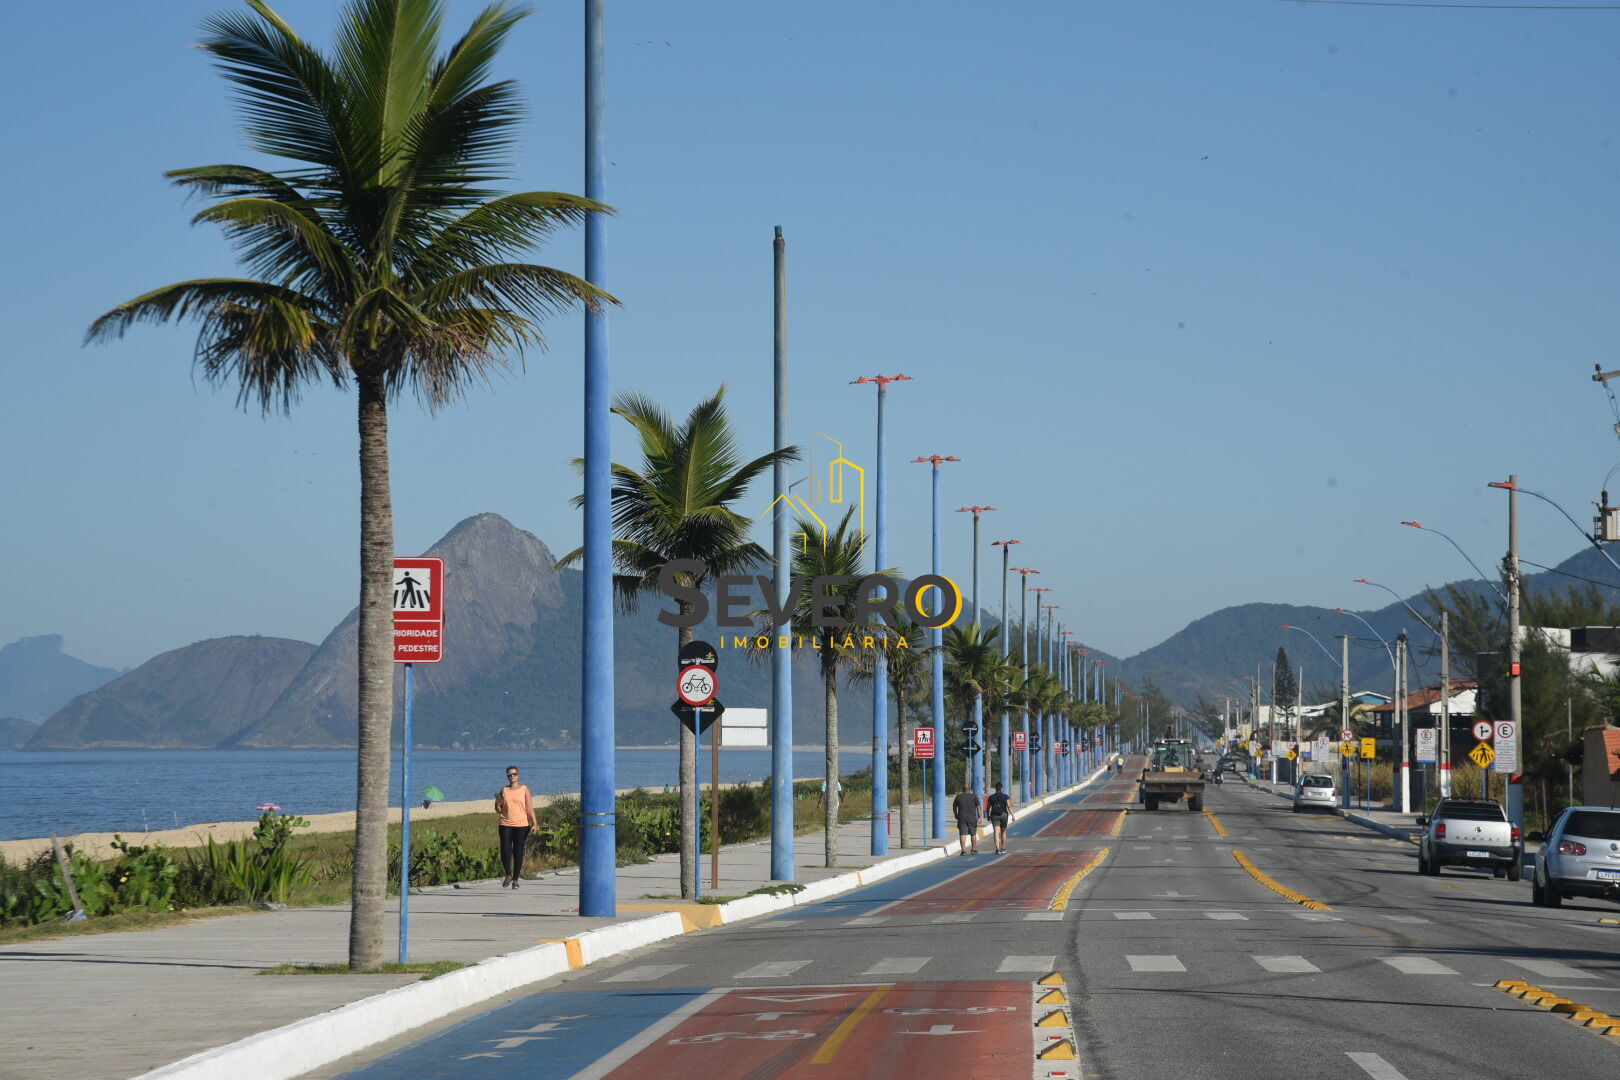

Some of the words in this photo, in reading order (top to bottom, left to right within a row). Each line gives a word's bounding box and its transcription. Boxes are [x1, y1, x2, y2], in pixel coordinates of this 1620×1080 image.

[393, 629, 438, 637] RIORIDADE
[398, 644, 439, 652] PEDESTRE
[1502, 726, 1508, 735] E
